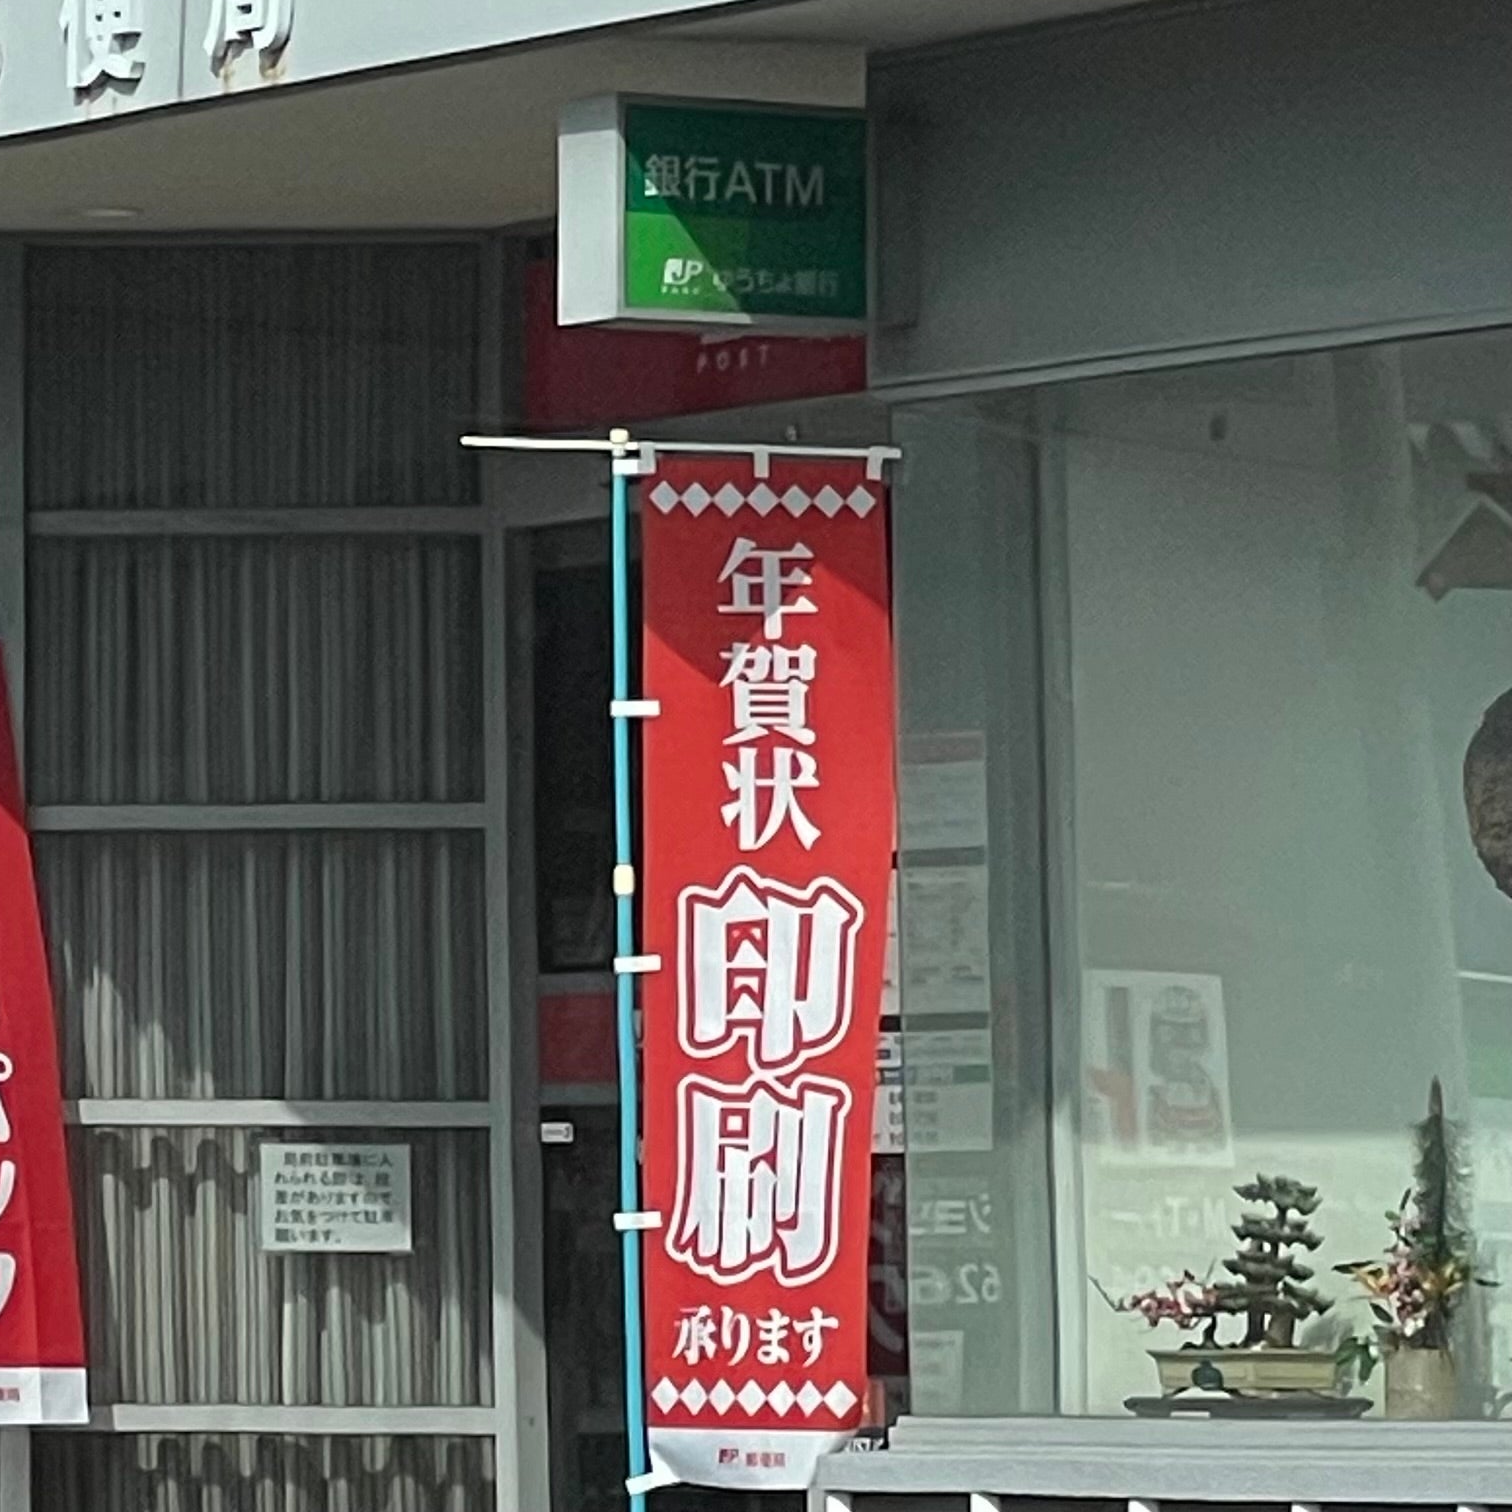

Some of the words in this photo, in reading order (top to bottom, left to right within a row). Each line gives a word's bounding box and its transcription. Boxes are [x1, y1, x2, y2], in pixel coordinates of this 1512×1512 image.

[643, 153, 825, 206] 銀行ATM
[663, 258, 704, 285] JP
[717, 537, 822, 852] 年賀状
[665, 865, 864, 1286] 印刷
[671, 1304, 839, 1368] 承ります
